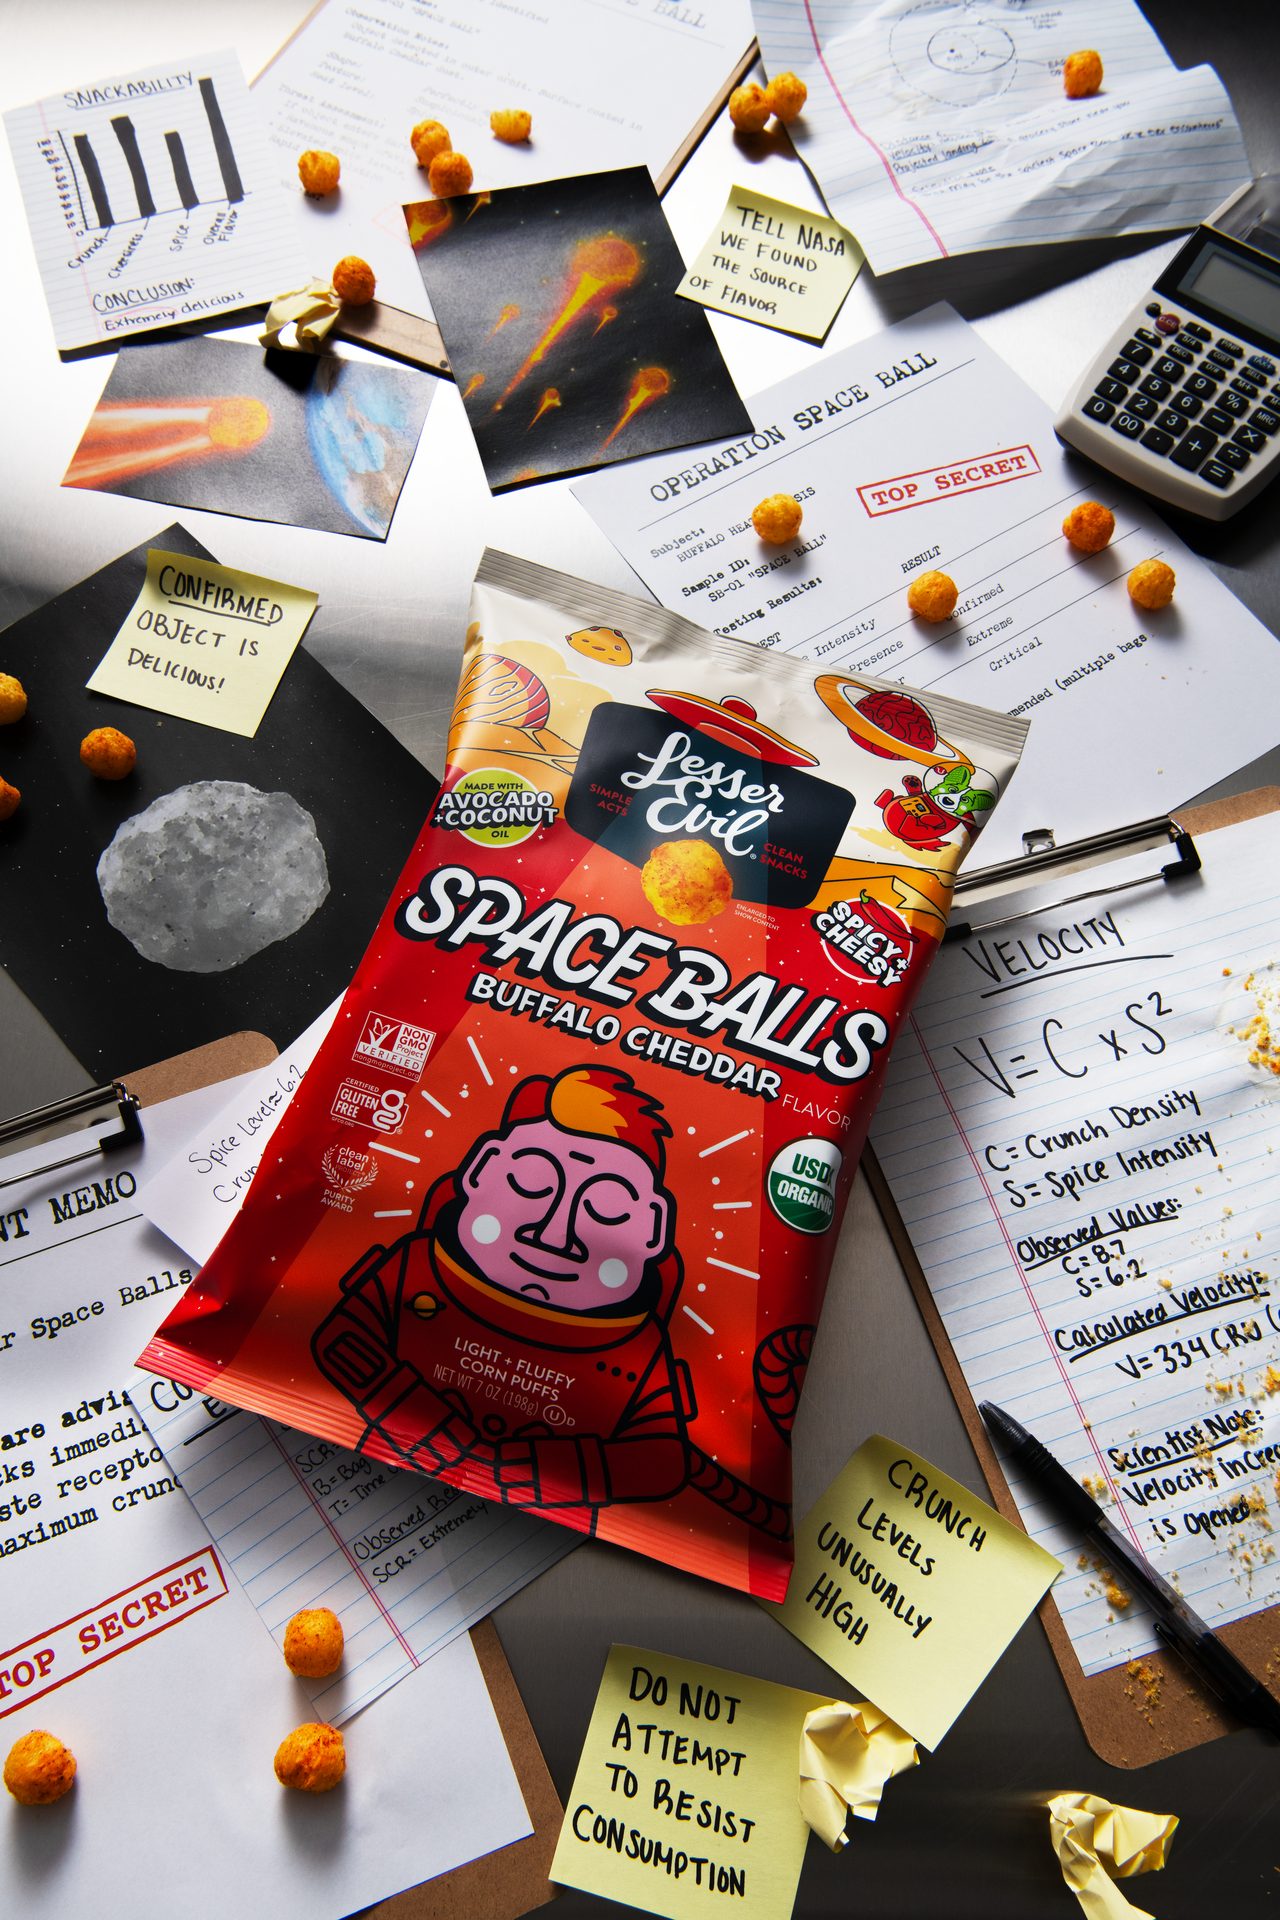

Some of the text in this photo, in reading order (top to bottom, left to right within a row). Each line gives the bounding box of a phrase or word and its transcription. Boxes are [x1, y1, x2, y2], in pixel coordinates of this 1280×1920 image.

[64, 72, 193, 108] SNACKABILITY
[736, 206, 845, 256] TELL NASA
[67, 236, 107, 270] Crunch
[721, 231, 817, 272] WE FOUND
[690, 276, 713, 290] OF
[712, 255, 807, 295] THE SOURCE
[93, 278, 195, 312] CONCLUSION:
[105, 292, 244, 331] Extremely delicious
[1130, 344, 1143, 355] 7
[1163, 361, 1174, 373] 8
[1118, 364, 1130, 375] 4
[1149, 380, 1160, 391] 5
[1194, 378, 1206, 390] 9
[1093, 401, 1105, 413] 0
[1109, 384, 1117, 393] 1
[1135, 399, 1148, 410] 2
[1181, 396, 1193, 408] 6
[650, 352, 938, 502] OPERATION SPACE BALL
[1118, 415, 1138, 430] 00
[1166, 415, 1178, 426] 3
[1256, 411, 1276, 426] MRC
[872, 455, 1027, 506] TOP SECRET
[650, 527, 705, 559] Subject:
[677, 533, 725, 563] BUFFALO
[748, 554, 791, 580] "SPACE
[793, 534, 827, 558] BALL"
[901, 545, 942, 574] RESULT
[160, 565, 283, 624] CONFIRMED
[681, 558, 750, 598] Sample ID:
[713, 577, 823, 636] Testing Results:
[813, 584, 1004, 657] Intensity onfirmed
[137, 610, 259, 656] OBJECT IS
[848, 615, 1014, 672] Presence Extreme
[128, 648, 225, 693] DELICIOUS!
[989, 636, 1044, 673] Critical
[1055, 634, 1148, 691] (multiple bags
[464, 782, 523, 790] MADE WITH
[620, 731, 785, 813] Lesser
[439, 791, 553, 810] AVOCADO
[590, 783, 633, 805] SIMPLE
[596, 800, 627, 817] ACTS
[491, 830, 509, 838] OIL
[646, 778, 770, 857] Evil
[759, 854, 808, 880] SNACKS
[763, 842, 804, 864] CLEAN
[734, 909, 780, 931] SHOW CONTENT
[736, 903, 776, 923] ENLARGED TO
[832, 901, 903, 959] SPICY
[816, 912, 902, 987] CHEESY
[962, 911, 1125, 983] VELOCITY
[403, 864, 889, 1081] SPACE BALLS
[396, 1044, 424, 1059] Project
[400, 1036, 427, 1051] GMO
[402, 1026, 431, 1043] NON
[470, 972, 783, 1099] BUFFALO CHEDDAR
[1043, 1018, 1088, 1078] C
[354, 1052, 420, 1081] nongmoproject.org
[361, 1044, 420, 1071] VERIFIED
[340, 1088, 380, 1111] GLUTEN
[345, 1077, 380, 1093] CERTIFIED
[335, 1100, 360, 1119] FREE
[782, 1093, 851, 1132] FLAVOR
[1025, 1119, 1108, 1159] Crunch
[1108, 1090, 1201, 1130] Density
[188, 1136, 241, 1173] Spice
[336, 1154, 366, 1172] label
[339, 1146, 369, 1163] clean
[1044, 1160, 1109, 1202] Spice
[1116, 1131, 1217, 1177] Intensity
[48, 1171, 137, 1224] MEMO
[320, 1196, 354, 1214] AWARD
[323, 1189, 356, 1205] PURITY
[777, 1179, 832, 1216] ORGANIC
[1017, 1197, 1182, 1263] Observed Values:
[1092, 1239, 1126, 1264] 8.7
[1105, 1259, 1147, 1286] 6.2
[31, 1268, 193, 1339] Space Balls
[1054, 1302, 1168, 1352] Calculated
[454, 1337, 576, 1389] LIGHT FLUFFY
[1153, 1336, 1211, 1374] 334
[433, 1364, 539, 1417] NET WT 7 OZ (198g)
[460, 1356, 560, 1402] CORN PUFFS
[0, 1423, 46, 1451] are
[1107, 1425, 1204, 1472] Scientist
[337, 1457, 372, 1480] Bag
[350, 1473, 385, 1500] Time
[1121, 1467, 1218, 1507] Velocity
[888, 1459, 987, 1552] CRUNCH
[353, 1505, 426, 1560] Observed
[419, 1502, 488, 1550] Extremely
[857, 1498, 936, 1576] LEVELS
[1148, 1518, 1177, 1543] is
[817, 1521, 933, 1639] UNUSUALLY
[78, 1566, 208, 1654] SECRET
[805, 1572, 869, 1645] HIGH
[629, 1666, 742, 1724] DO NOT
[612, 1712, 746, 1776] ATTEMPT
[605, 1762, 756, 1843] TO RESIST
[572, 1804, 746, 1897] CONSUMPTION
